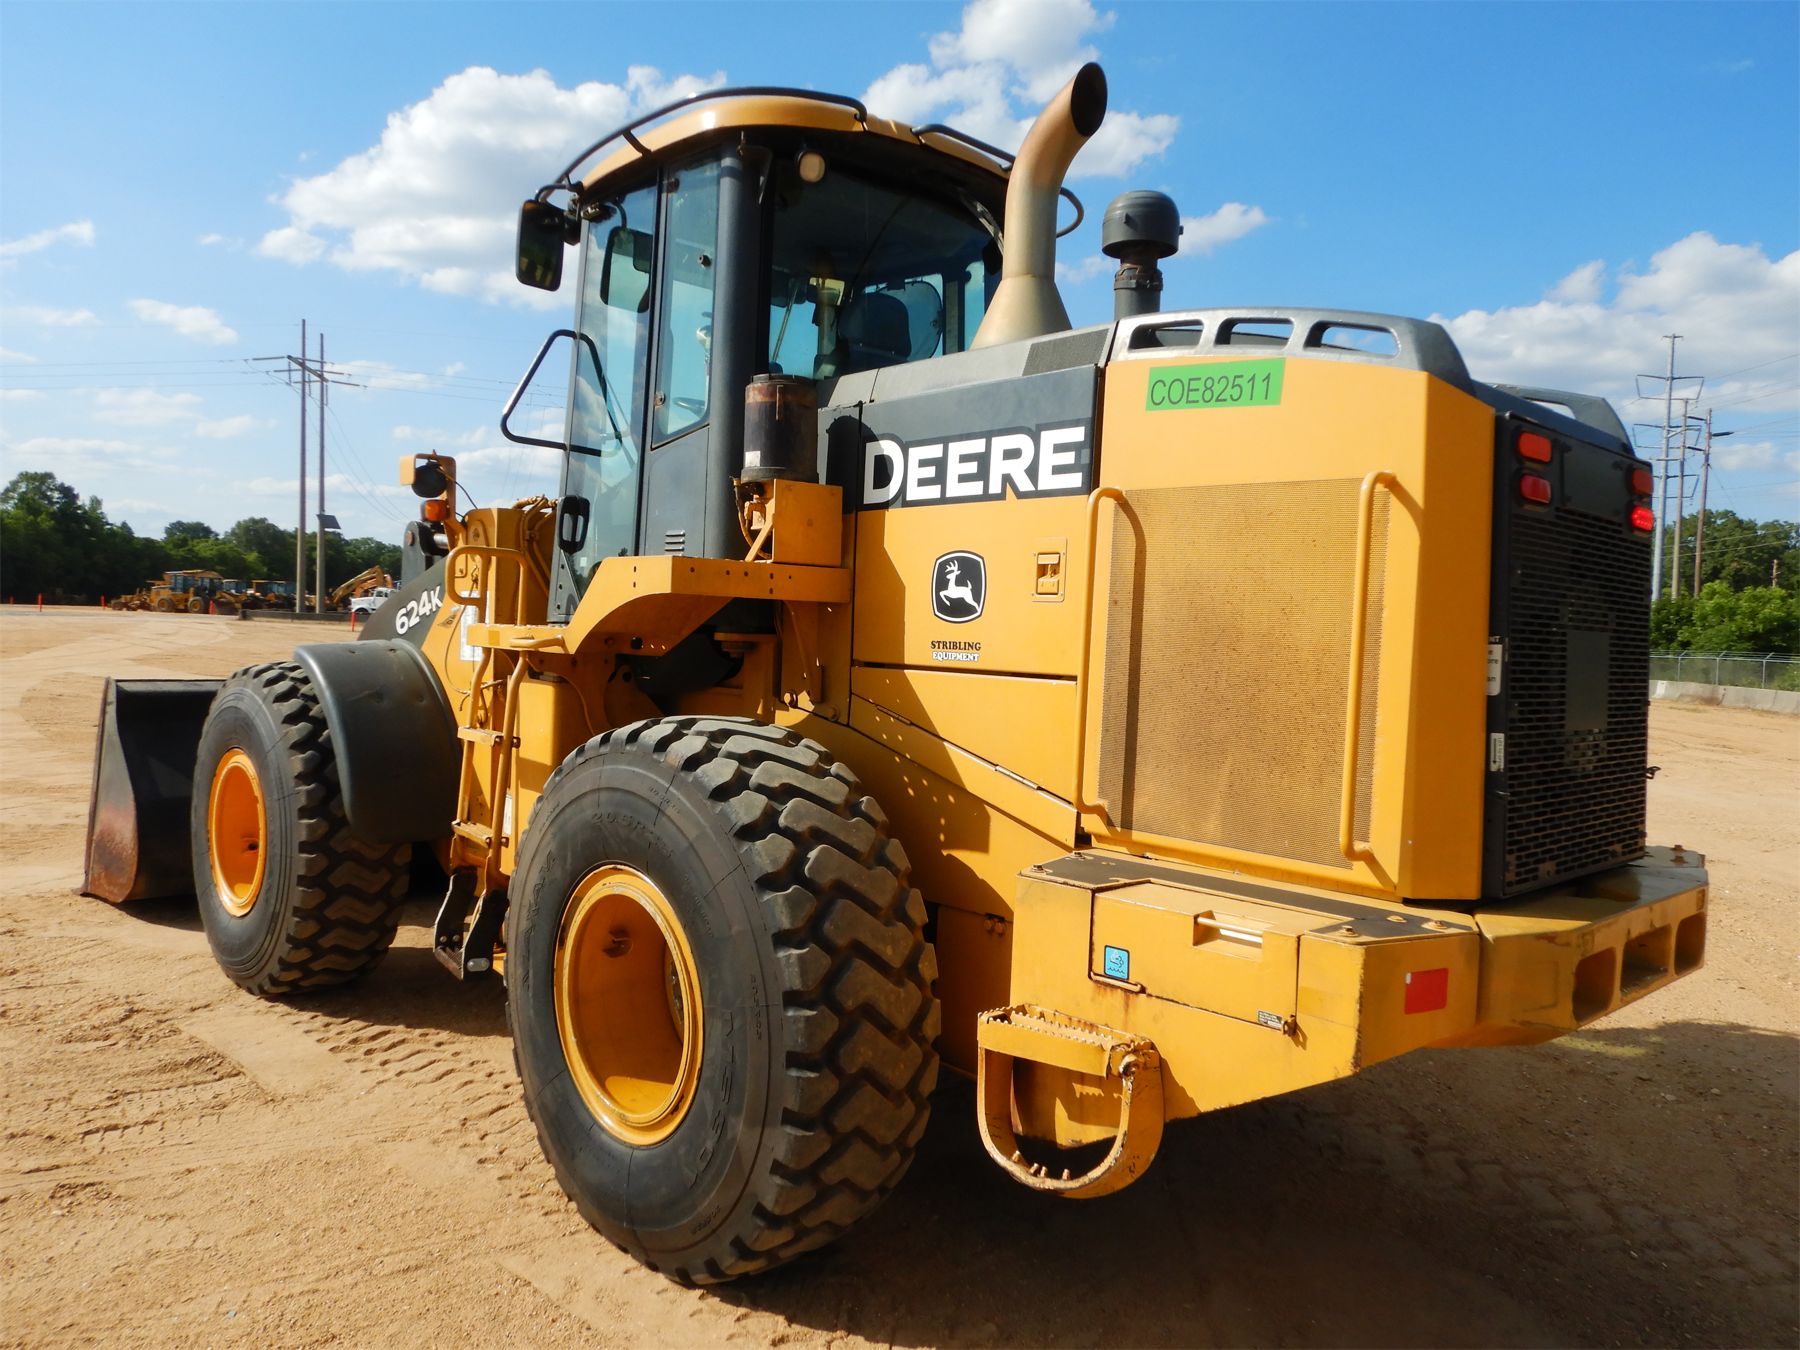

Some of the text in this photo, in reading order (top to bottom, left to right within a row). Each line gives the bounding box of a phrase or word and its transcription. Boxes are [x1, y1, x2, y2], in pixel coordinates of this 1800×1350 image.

[1150, 372, 1272, 406] COE82511
[863, 426, 1086, 505] DEERE
[395, 585, 443, 636] 624K
[930, 640, 982, 651] STRIBLING
[932, 651, 980, 662] EQUIPMENT
